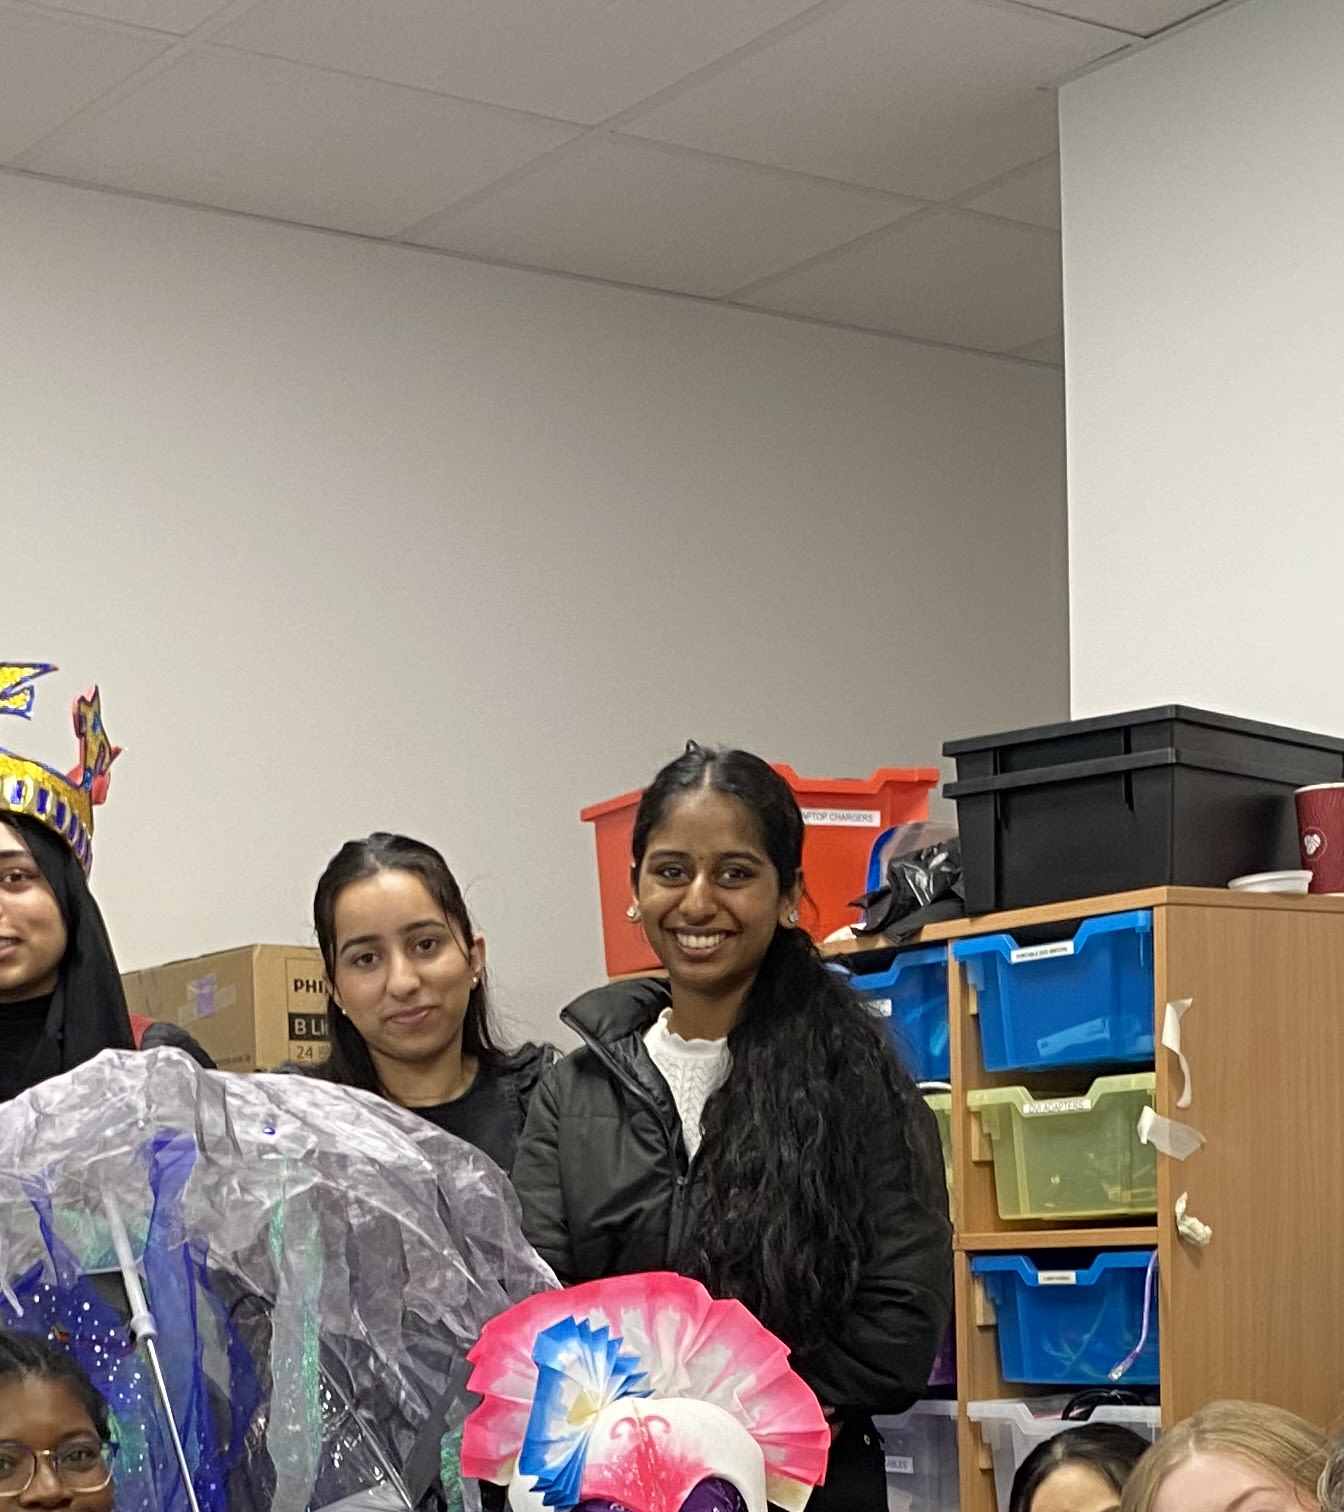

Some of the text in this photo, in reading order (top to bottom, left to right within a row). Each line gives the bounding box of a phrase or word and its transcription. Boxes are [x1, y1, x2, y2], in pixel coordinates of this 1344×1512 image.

[829, 812, 875, 823] CHARGERS
[294, 1018, 307, 1036] B
[296, 1045, 313, 1060] 24
